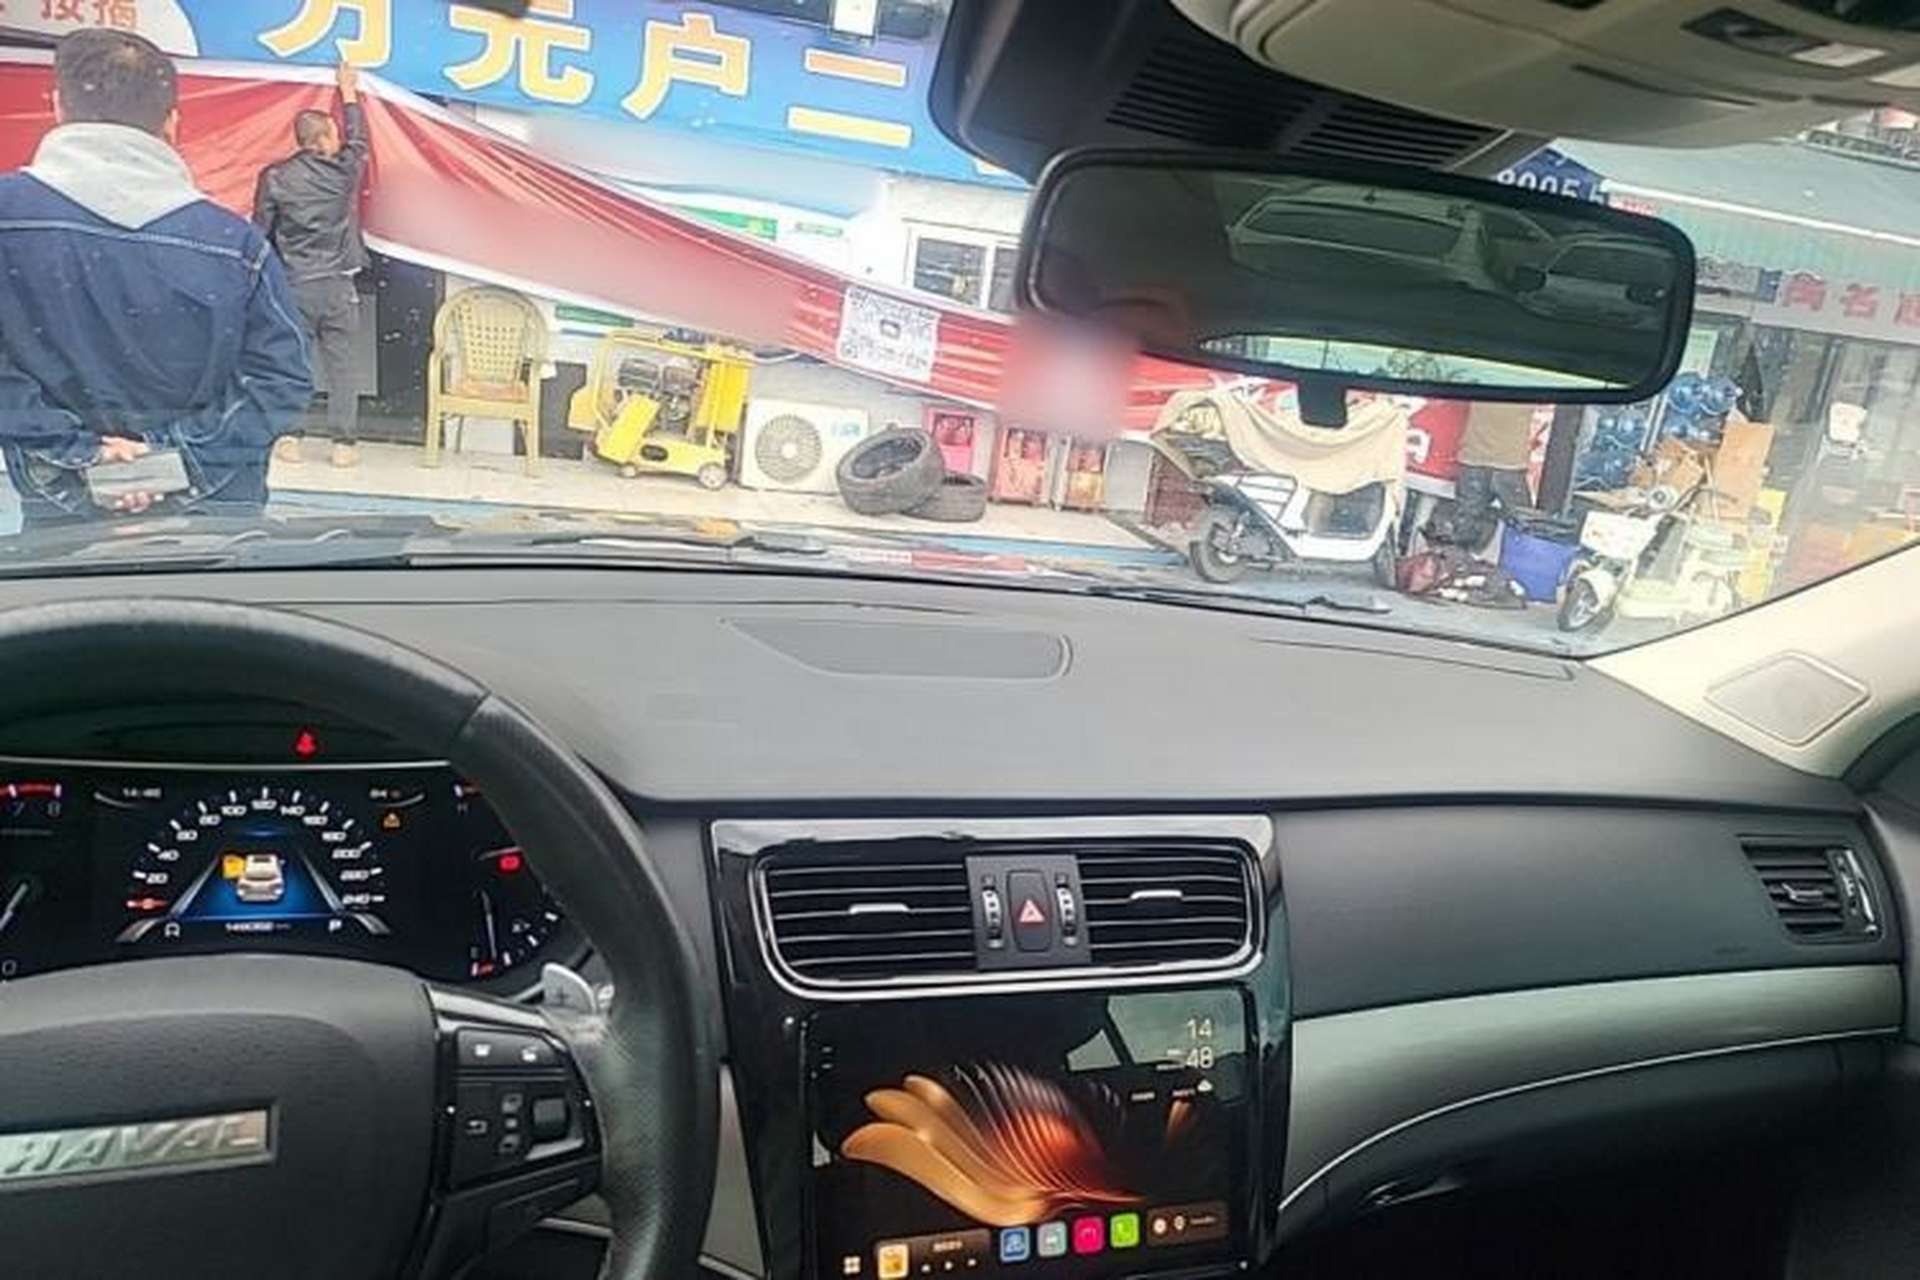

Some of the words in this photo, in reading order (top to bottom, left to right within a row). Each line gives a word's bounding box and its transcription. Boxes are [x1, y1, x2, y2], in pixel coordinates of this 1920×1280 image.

[256, 0, 1003, 177] 万元户二
[221, 805, 247, 816] 100
[157, 849, 180, 861] 40
[146, 872, 169, 884] 20
[1187, 1018, 1213, 1040] 14
[1186, 1046, 1215, 1069] 48
